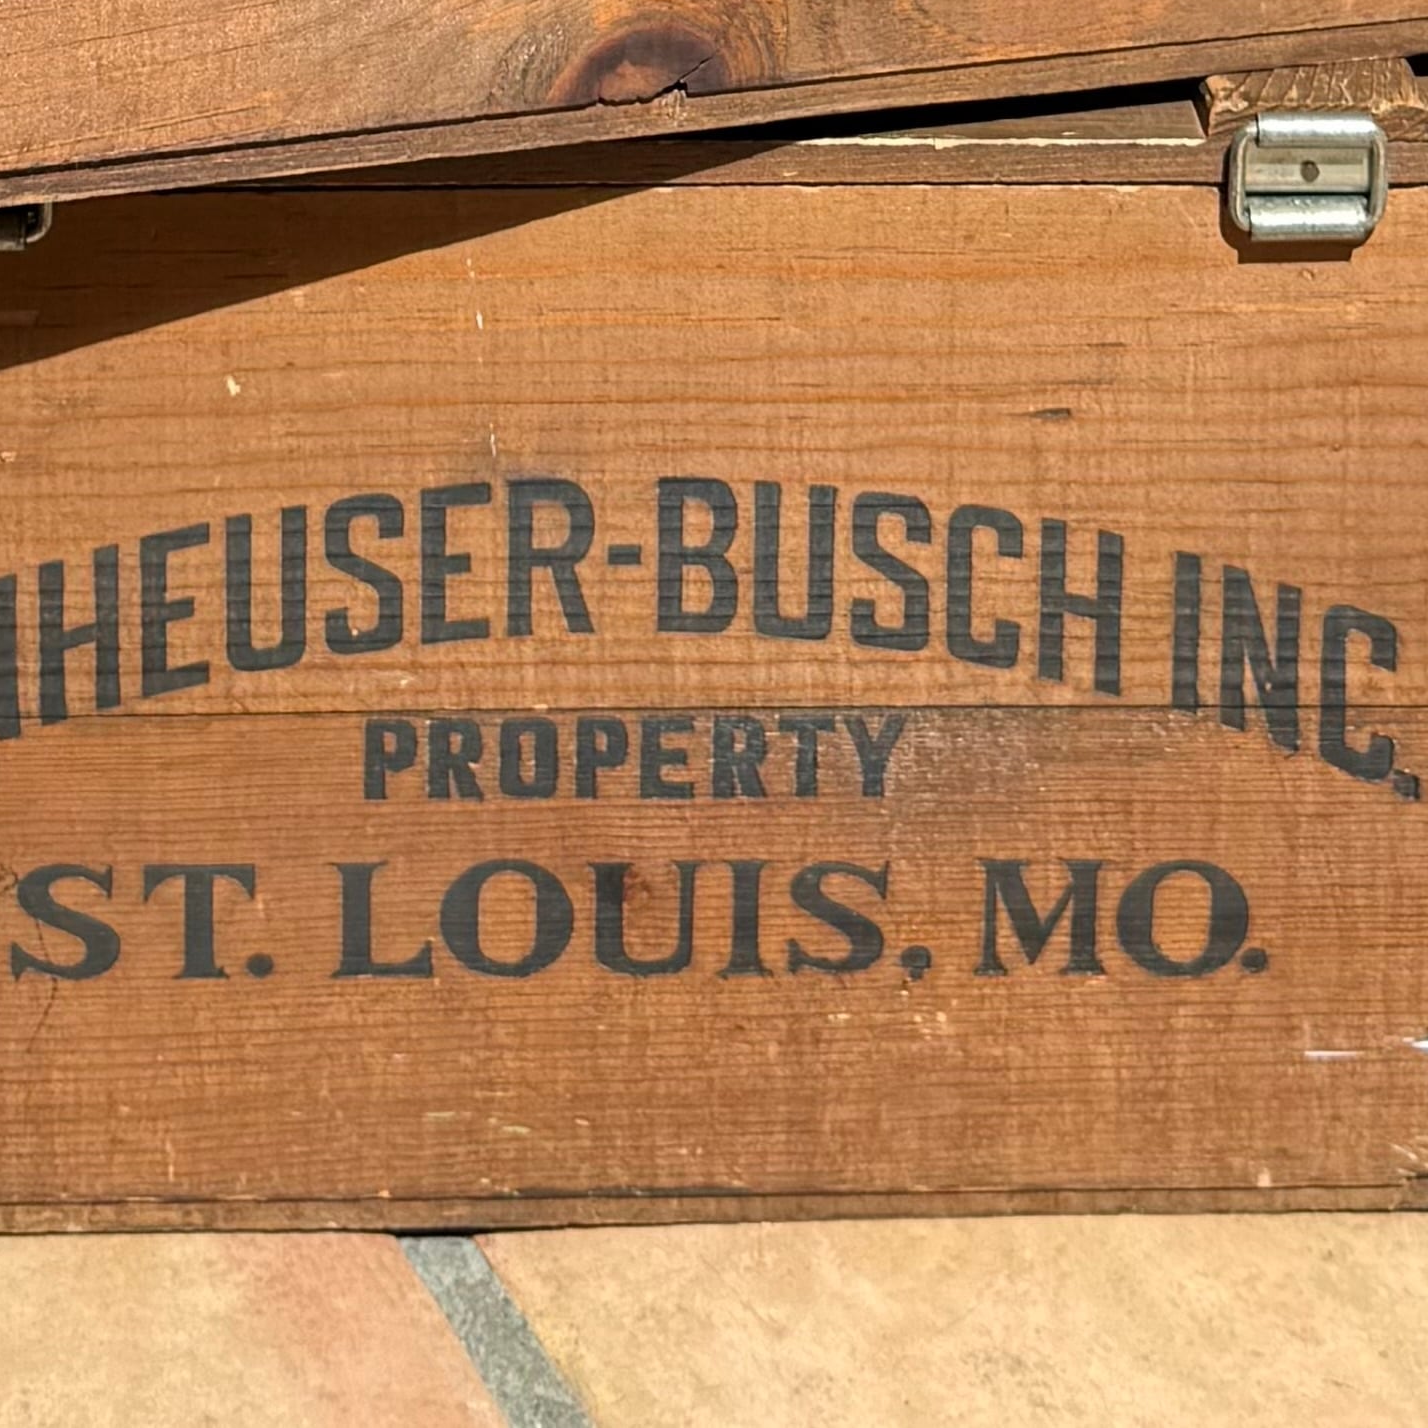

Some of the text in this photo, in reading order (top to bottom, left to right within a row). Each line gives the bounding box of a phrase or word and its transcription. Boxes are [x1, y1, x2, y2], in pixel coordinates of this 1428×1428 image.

[1171, 552, 1422, 800] INC.
[363, 713, 911, 803] PROPERTY
[9, 861, 274, 981] ST.
[975, 856, 1271, 980] MO.
